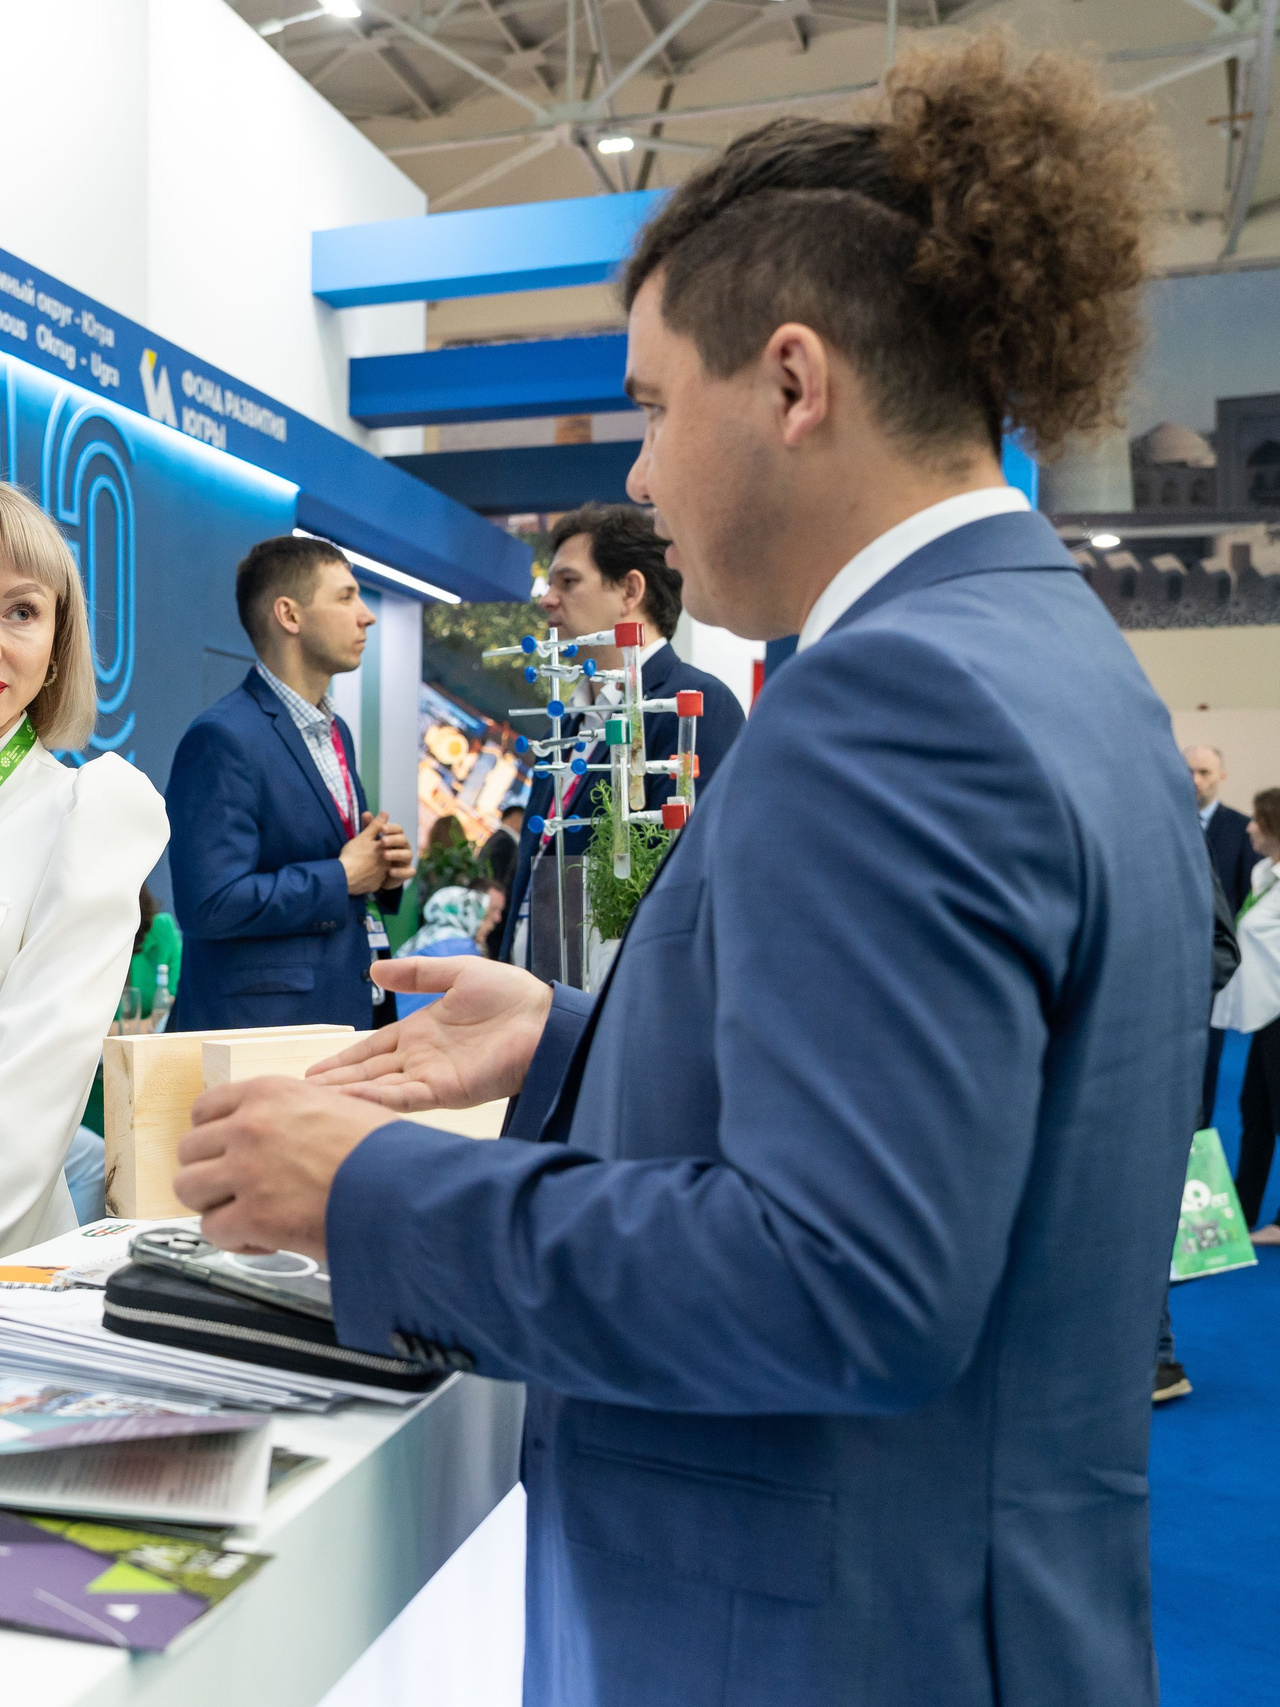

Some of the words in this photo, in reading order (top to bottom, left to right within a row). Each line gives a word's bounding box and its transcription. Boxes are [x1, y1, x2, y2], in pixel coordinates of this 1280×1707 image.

[36, 292, 74, 328] округ
[81, 309, 115, 349] Югра
[35, 323, 77, 371] Okrug
[90, 351, 120, 388] Ugra
[181, 368, 224, 416] ФОНД
